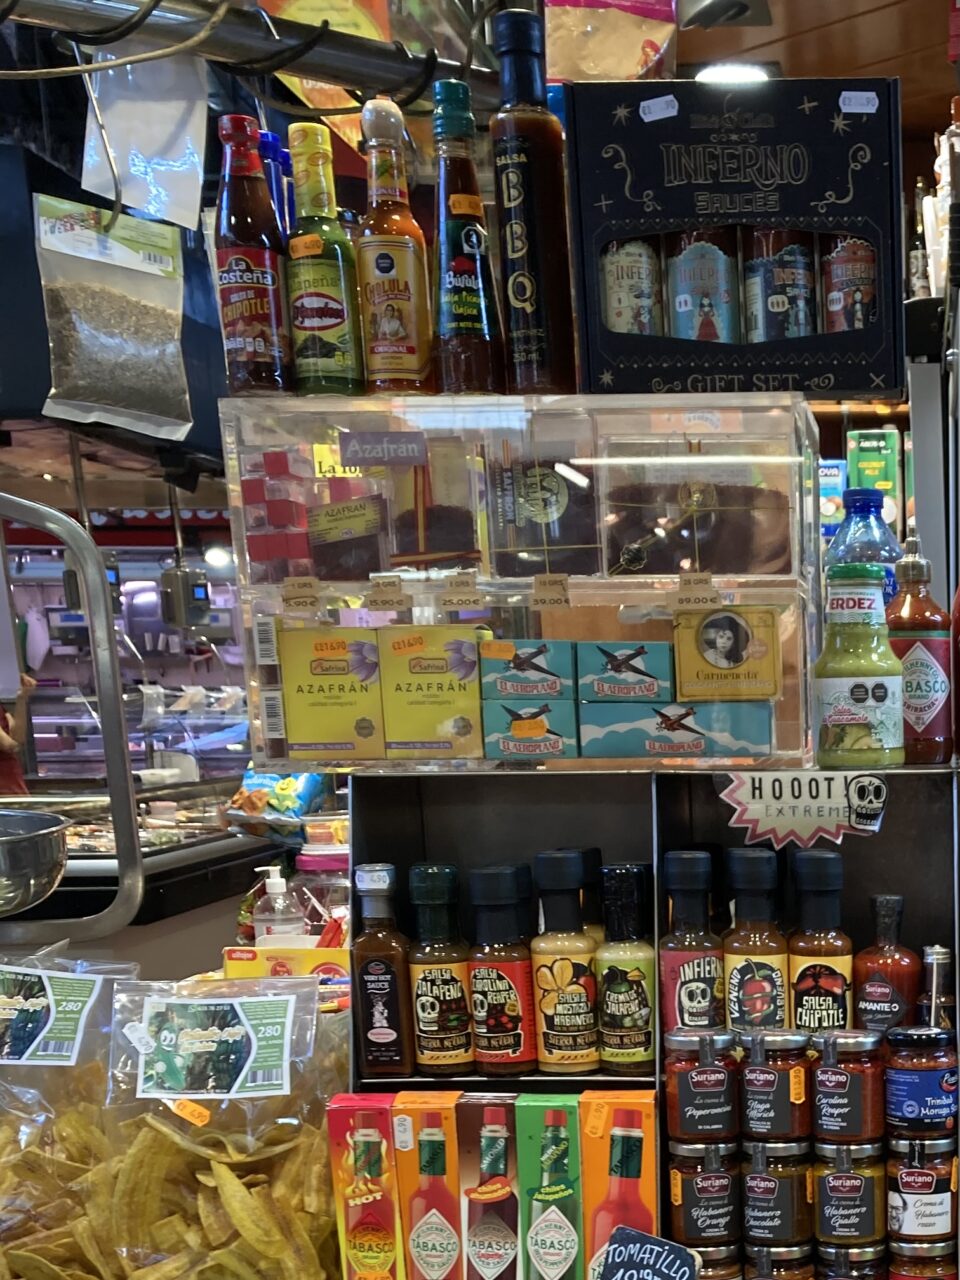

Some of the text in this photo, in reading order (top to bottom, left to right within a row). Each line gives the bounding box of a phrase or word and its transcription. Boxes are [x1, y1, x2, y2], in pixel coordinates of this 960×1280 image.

[496, 153, 528, 166] SALSA
[661, 143, 809, 190] INFERNO
[695, 192, 780, 213] SAUCES
[364, 280, 412, 298] CHOLULA
[223, 299, 270, 321] CHIPOTLE
[687, 374, 799, 392] GIFT SET
[346, 438, 420, 463] Azafrán
[696, 668, 760, 681] Carmencita
[296, 681, 369, 694] AZAFRÁN
[395, 680, 467, 692] AZAFRÁN
[513, 682, 557, 693] AEROPLANO
[609, 682, 656, 695] AEROPLANO
[515, 741, 560, 751] AEROPLANO
[659, 741, 703, 751] AEROPLANO
[764, 804, 851, 818] EXTREME
[424, 968, 450, 980] SALSA
[475, 968, 498, 979] SALSA
[366, 981, 389, 989] SAUCE
[487, 990, 516, 1004] REAPER
[803, 996, 832, 1010] SALSA
[57, 1001, 82, 1012] 280
[796, 1008, 845, 1028] CHIPOTLE
[257, 1025, 281, 1037] 280
[692, 1071, 725, 1083] Suriano
[745, 1071, 775, 1083] Suriano
[817, 1071, 847, 1083] Suriano
[816, 1094, 848, 1106] Carolina
[697, 1177, 729, 1189] Suriano
[348, 1191, 383, 1208] HOT
[691, 1205, 733, 1219] Habanero
[823, 1205, 867, 1218] Habanero
[698, 1216, 732, 1228] Orange
[348, 1240, 393, 1253] TABASCO
[411, 1239, 459, 1251] TABASCO
[467, 1239, 518, 1251] TABASCO
[529, 1237, 576, 1251] TABASCO
